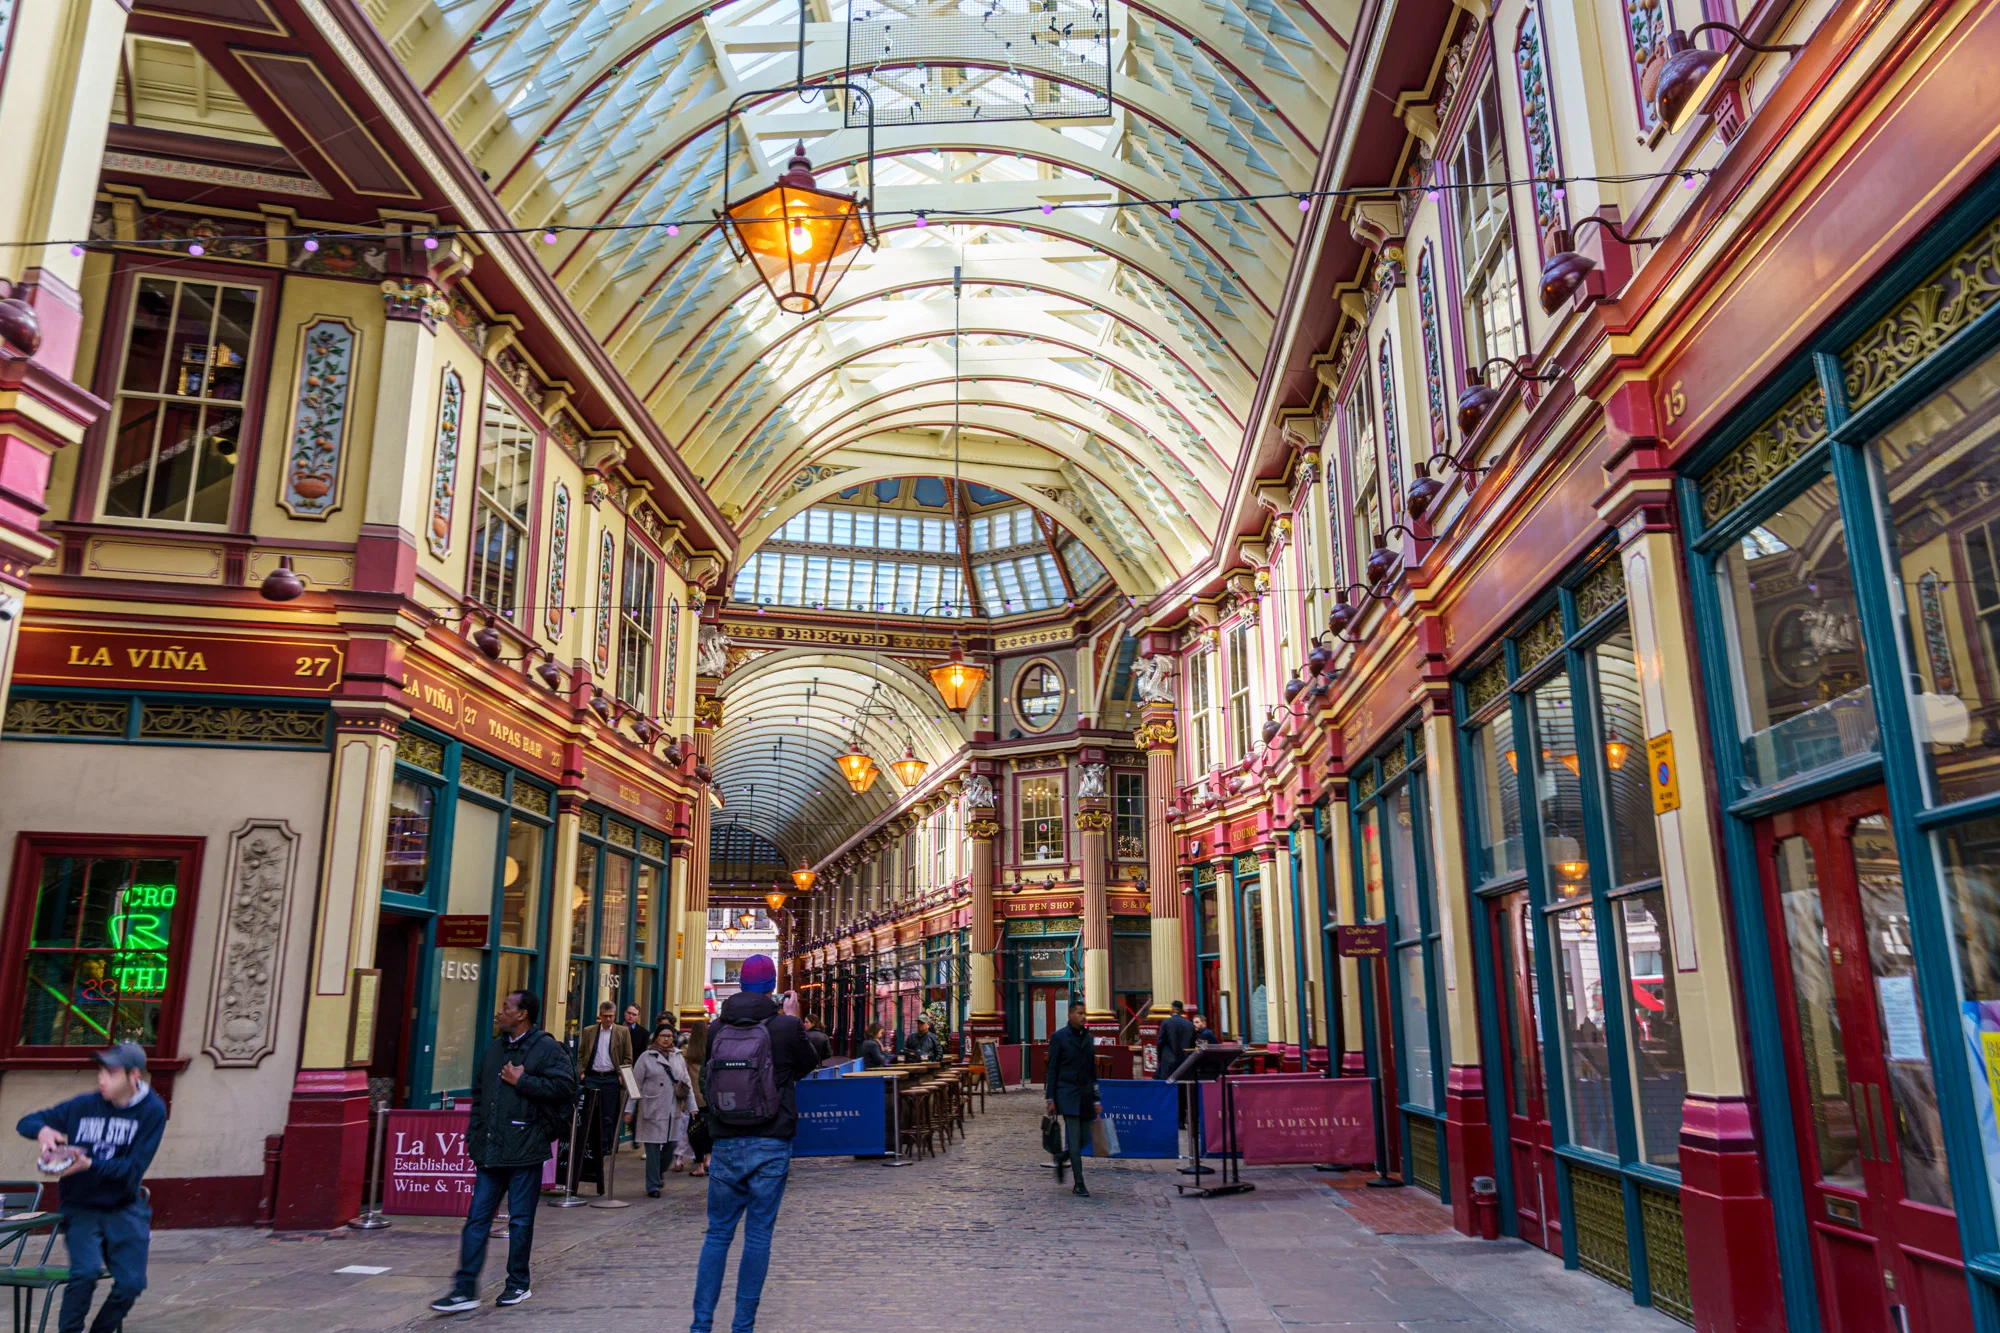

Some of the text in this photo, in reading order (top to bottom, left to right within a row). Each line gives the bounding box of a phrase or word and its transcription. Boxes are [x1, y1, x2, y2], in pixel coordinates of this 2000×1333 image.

[1664, 380, 1687, 426] 15
[781, 627, 889, 646] ERECTED
[67, 645, 332, 677] LA VIÑA 27
[401, 673, 454, 715] LA VIÑA
[464, 706, 478, 726] 27
[488, 719, 521, 749] TAPAS
[522, 736, 543, 759] BAR
[1010, 901, 1075, 912] THE PEN SHOP
[1122, 901, 1127, 909] 8
[1130, 901, 1137, 909] &
[1097, 1112, 1153, 1121] ADENHALL
[1256, 1116, 1361, 1129] LEADENHALL
[1279, 1128, 1336, 1138] MARKET
[395, 1132, 470, 1157] La Vi
[394, 1157, 477, 1172] Established 2
[394, 1178, 430, 1193] Wine
[434, 1179, 449, 1193] &
